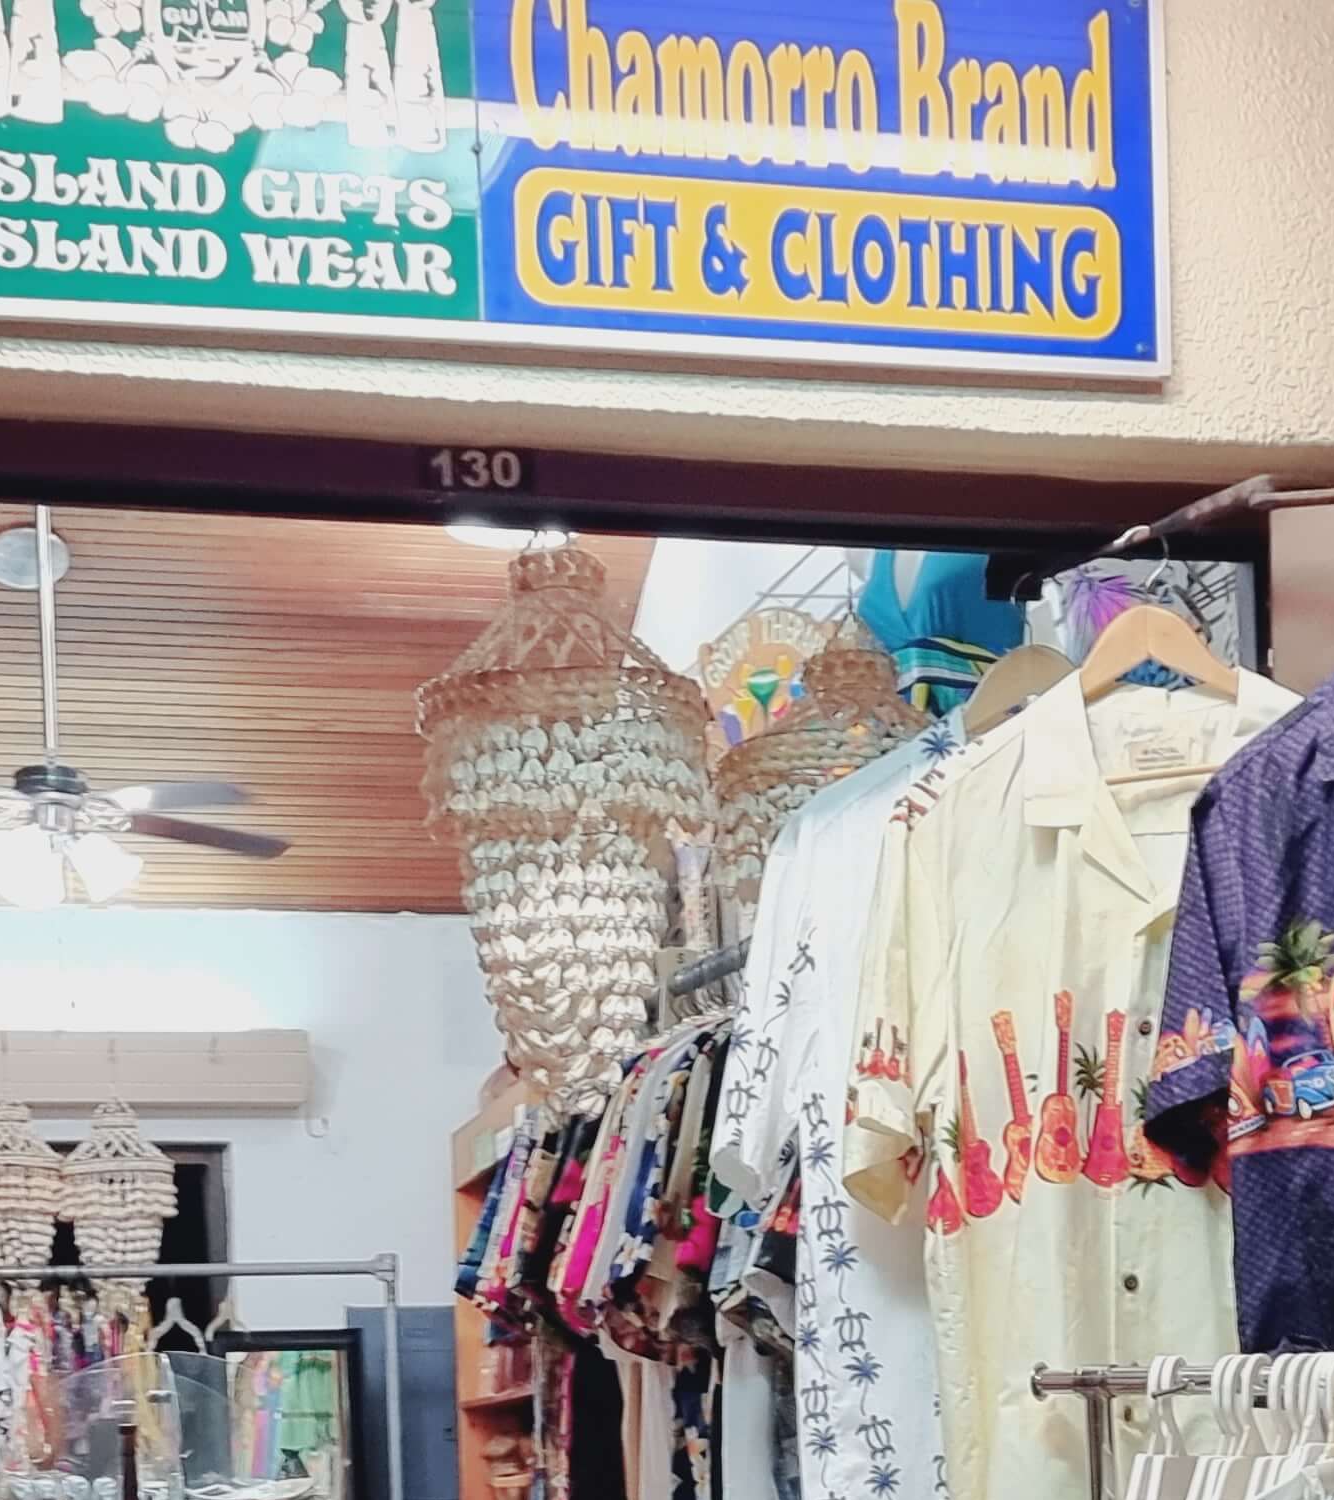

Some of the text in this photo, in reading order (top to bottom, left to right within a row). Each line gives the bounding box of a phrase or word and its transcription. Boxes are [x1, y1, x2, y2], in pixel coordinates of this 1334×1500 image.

[163, 7, 248, 27] GUAM
[510, 0, 1116, 189] Chamorro Brand
[242, 168, 453, 230] GIFTS
[242, 232, 457, 295] WEAR
[536, 190, 1100, 320] GIFT & CLOTHING
[430, 448, 521, 488] 130
